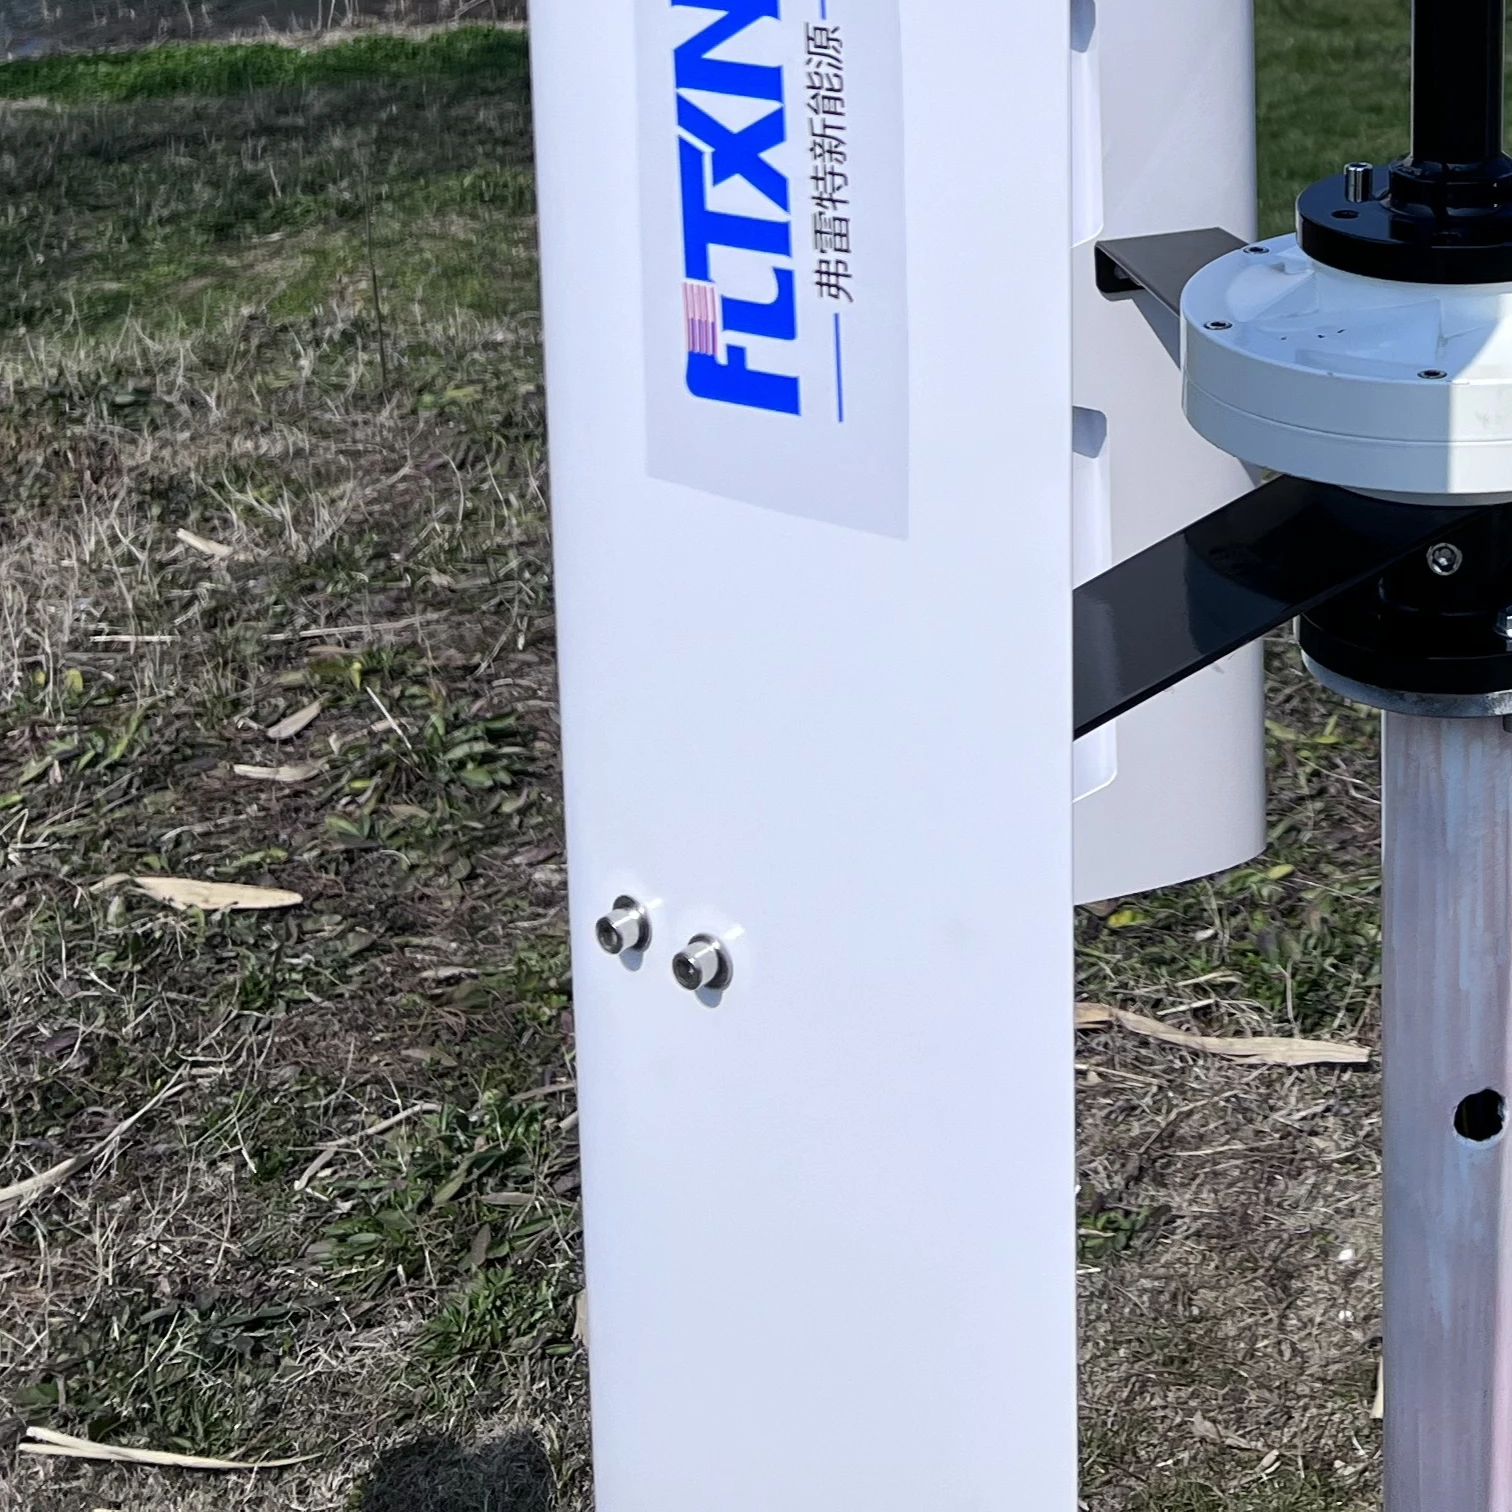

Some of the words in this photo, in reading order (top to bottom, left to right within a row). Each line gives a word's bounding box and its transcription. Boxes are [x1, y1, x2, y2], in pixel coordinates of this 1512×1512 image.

[804, 21, 853, 303] 弗雷特新能源
